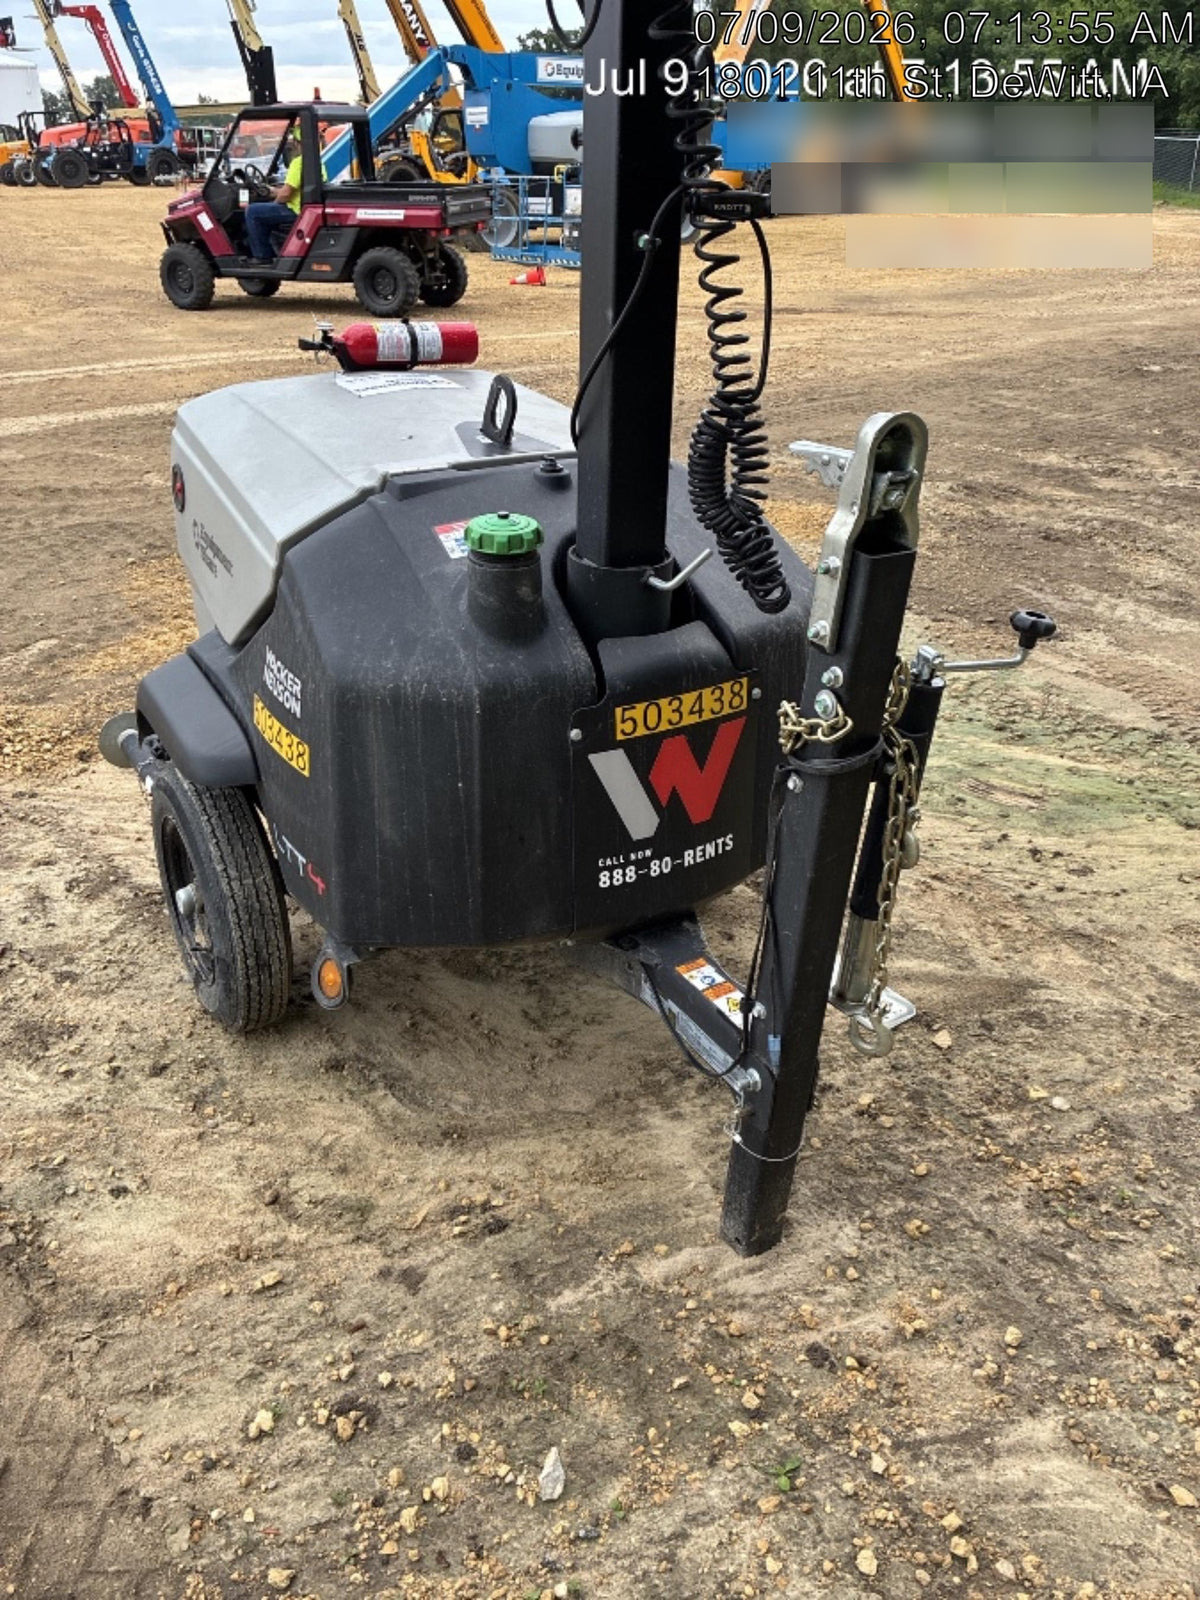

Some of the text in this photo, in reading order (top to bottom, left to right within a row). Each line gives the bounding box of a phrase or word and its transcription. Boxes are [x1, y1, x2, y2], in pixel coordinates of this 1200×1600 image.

[262, 663, 301, 719] NEUSON
[265, 644, 302, 700] WACKER
[619, 680, 745, 737] 503438
[598, 848, 653, 867] CALL NOW
[598, 833, 734, 888] 888-80-RENTS
